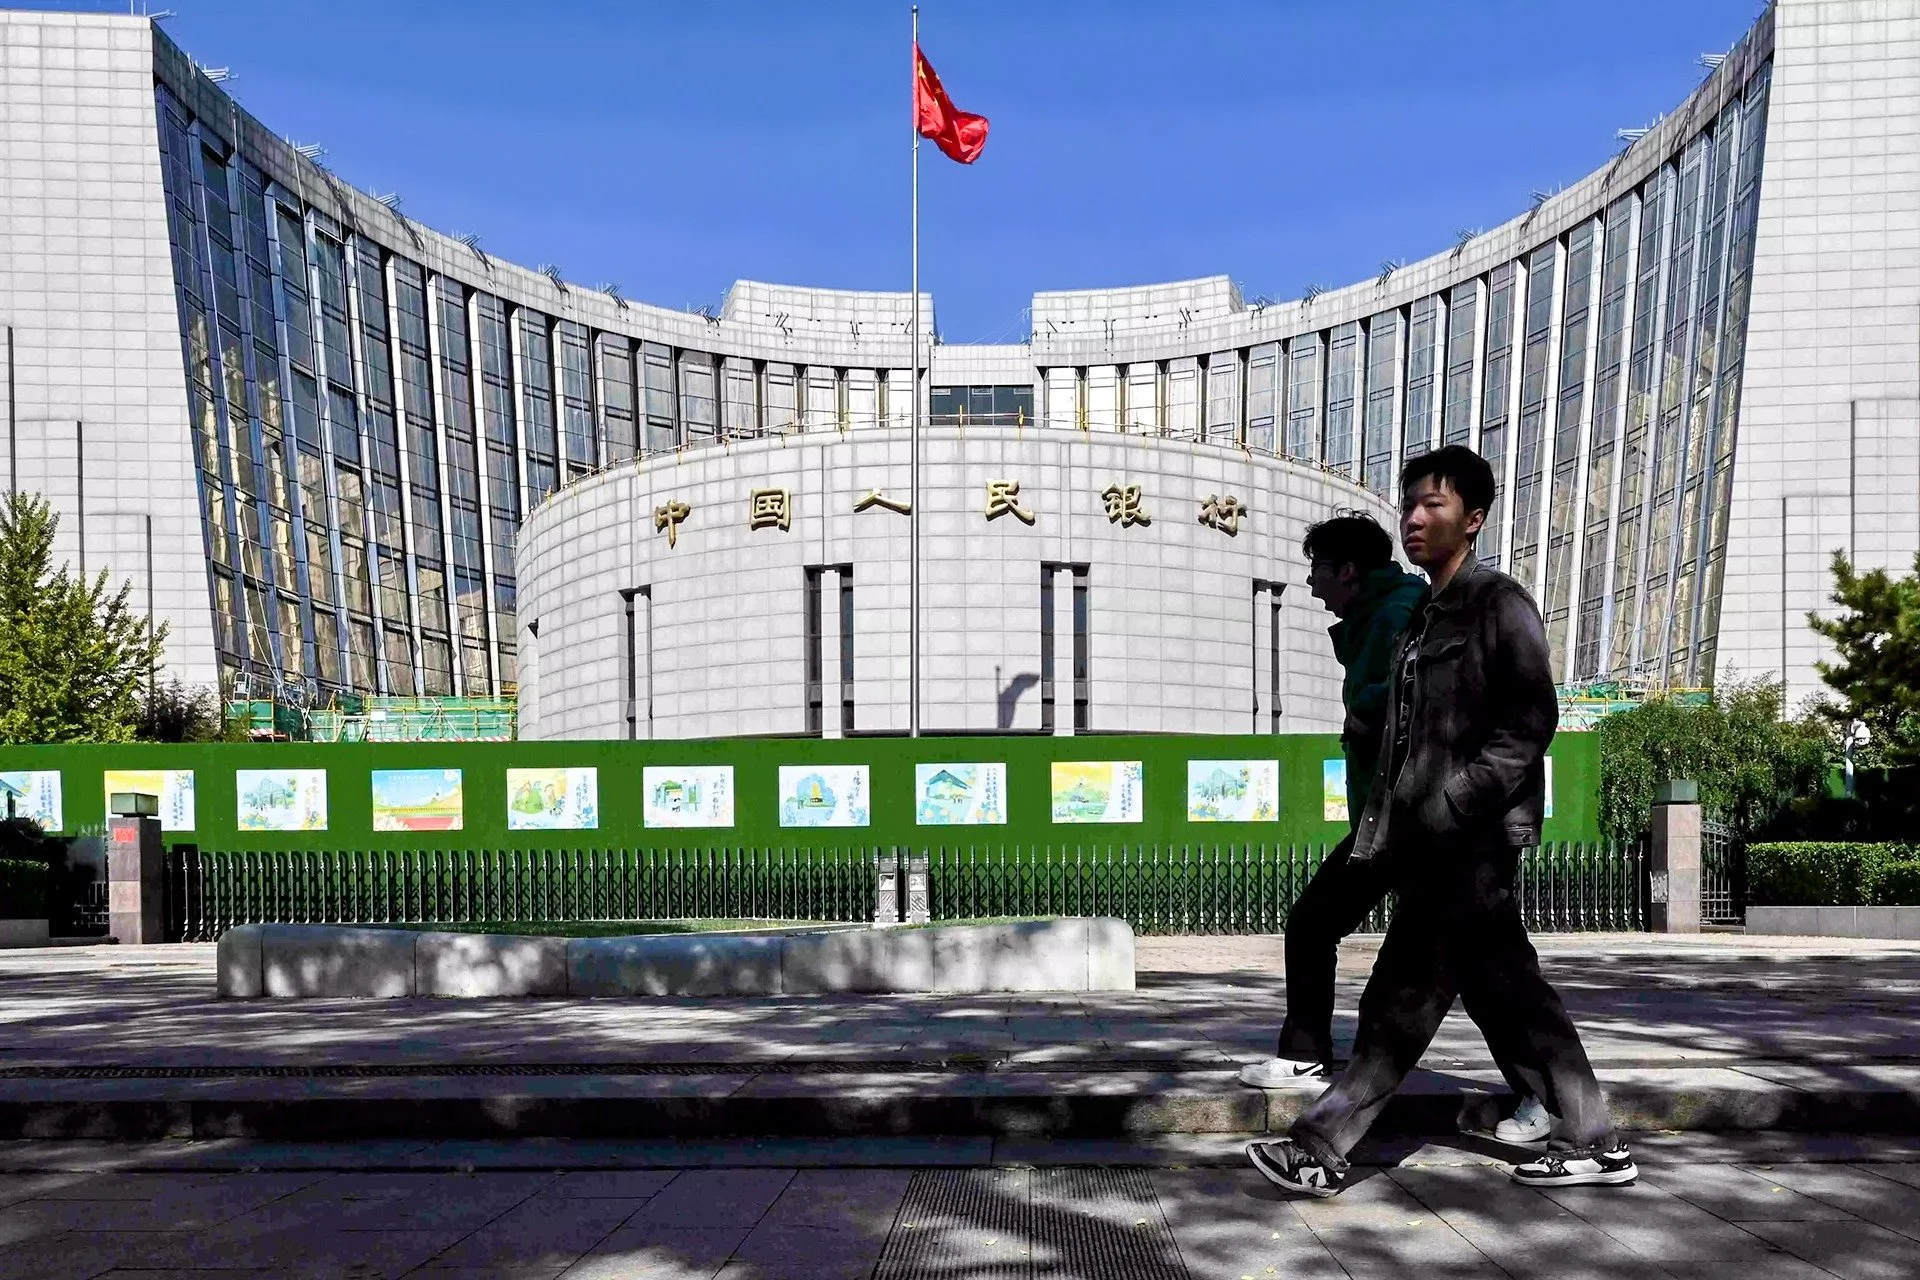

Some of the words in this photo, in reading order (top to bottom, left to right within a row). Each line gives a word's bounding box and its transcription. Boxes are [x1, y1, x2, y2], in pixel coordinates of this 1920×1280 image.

[655, 477, 1247, 549] 中国人民银行
